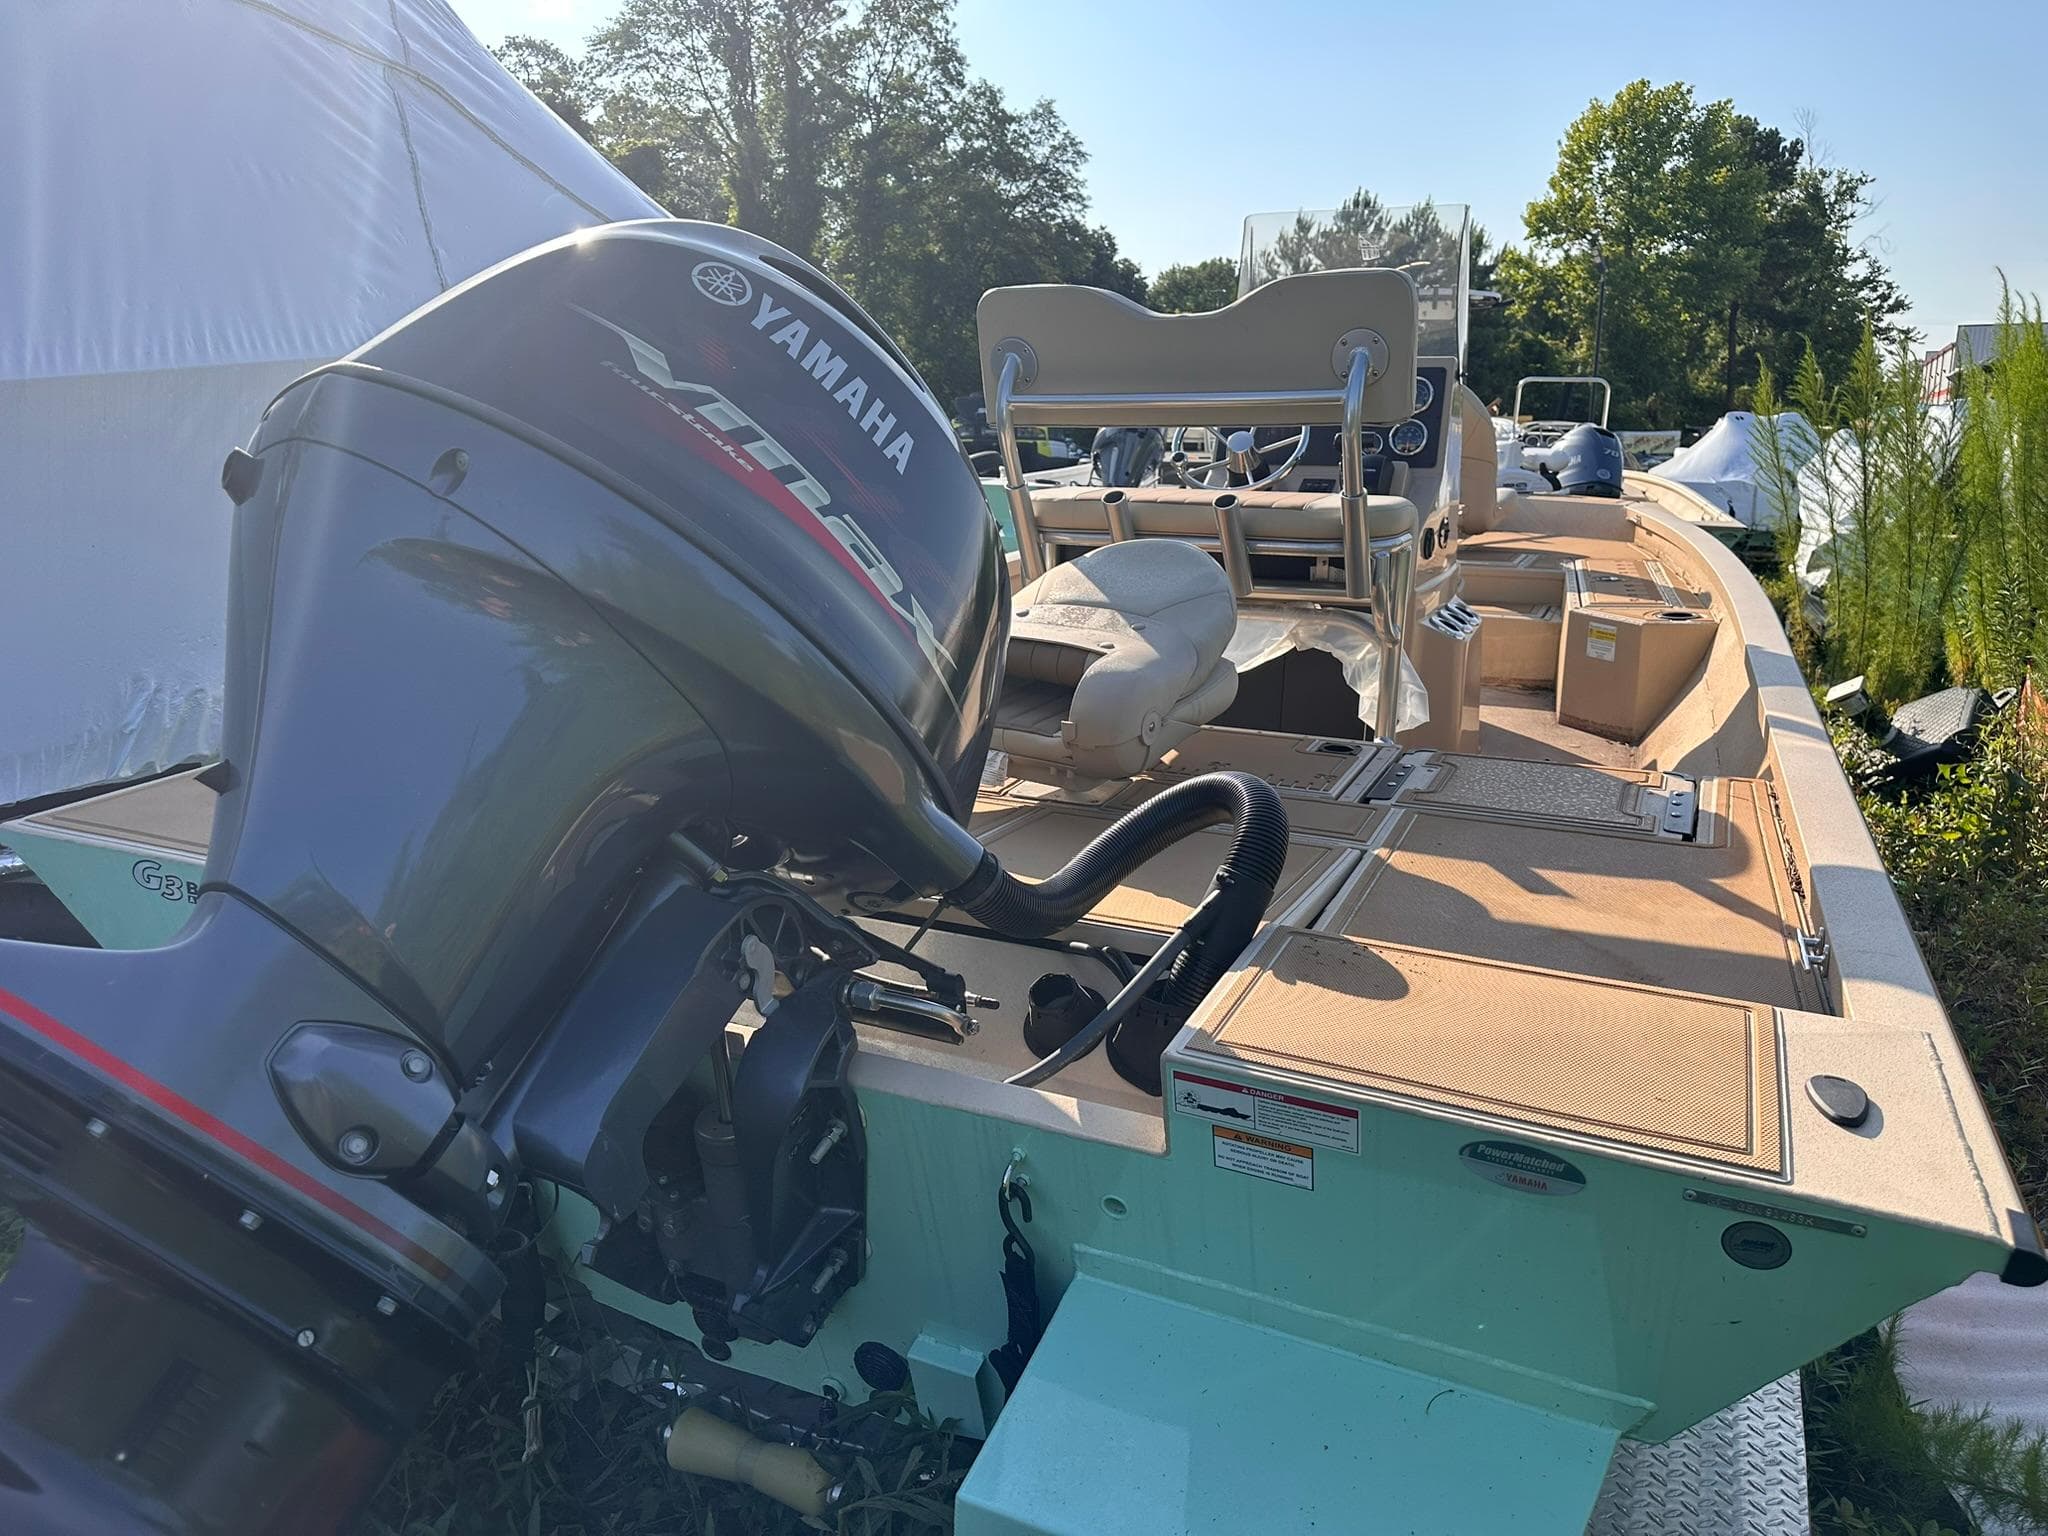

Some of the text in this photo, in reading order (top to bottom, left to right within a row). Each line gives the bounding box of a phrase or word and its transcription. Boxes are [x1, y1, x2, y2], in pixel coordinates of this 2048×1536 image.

[751, 293, 915, 476] YAMAHA
[132, 859, 184, 901] G3
[1250, 1088, 1285, 1101] DANGER
[1245, 1135, 1292, 1152] WARNING
[1477, 1143, 1566, 1172] PowerMatched
[1505, 1172, 1548, 1191] YAMAHA
